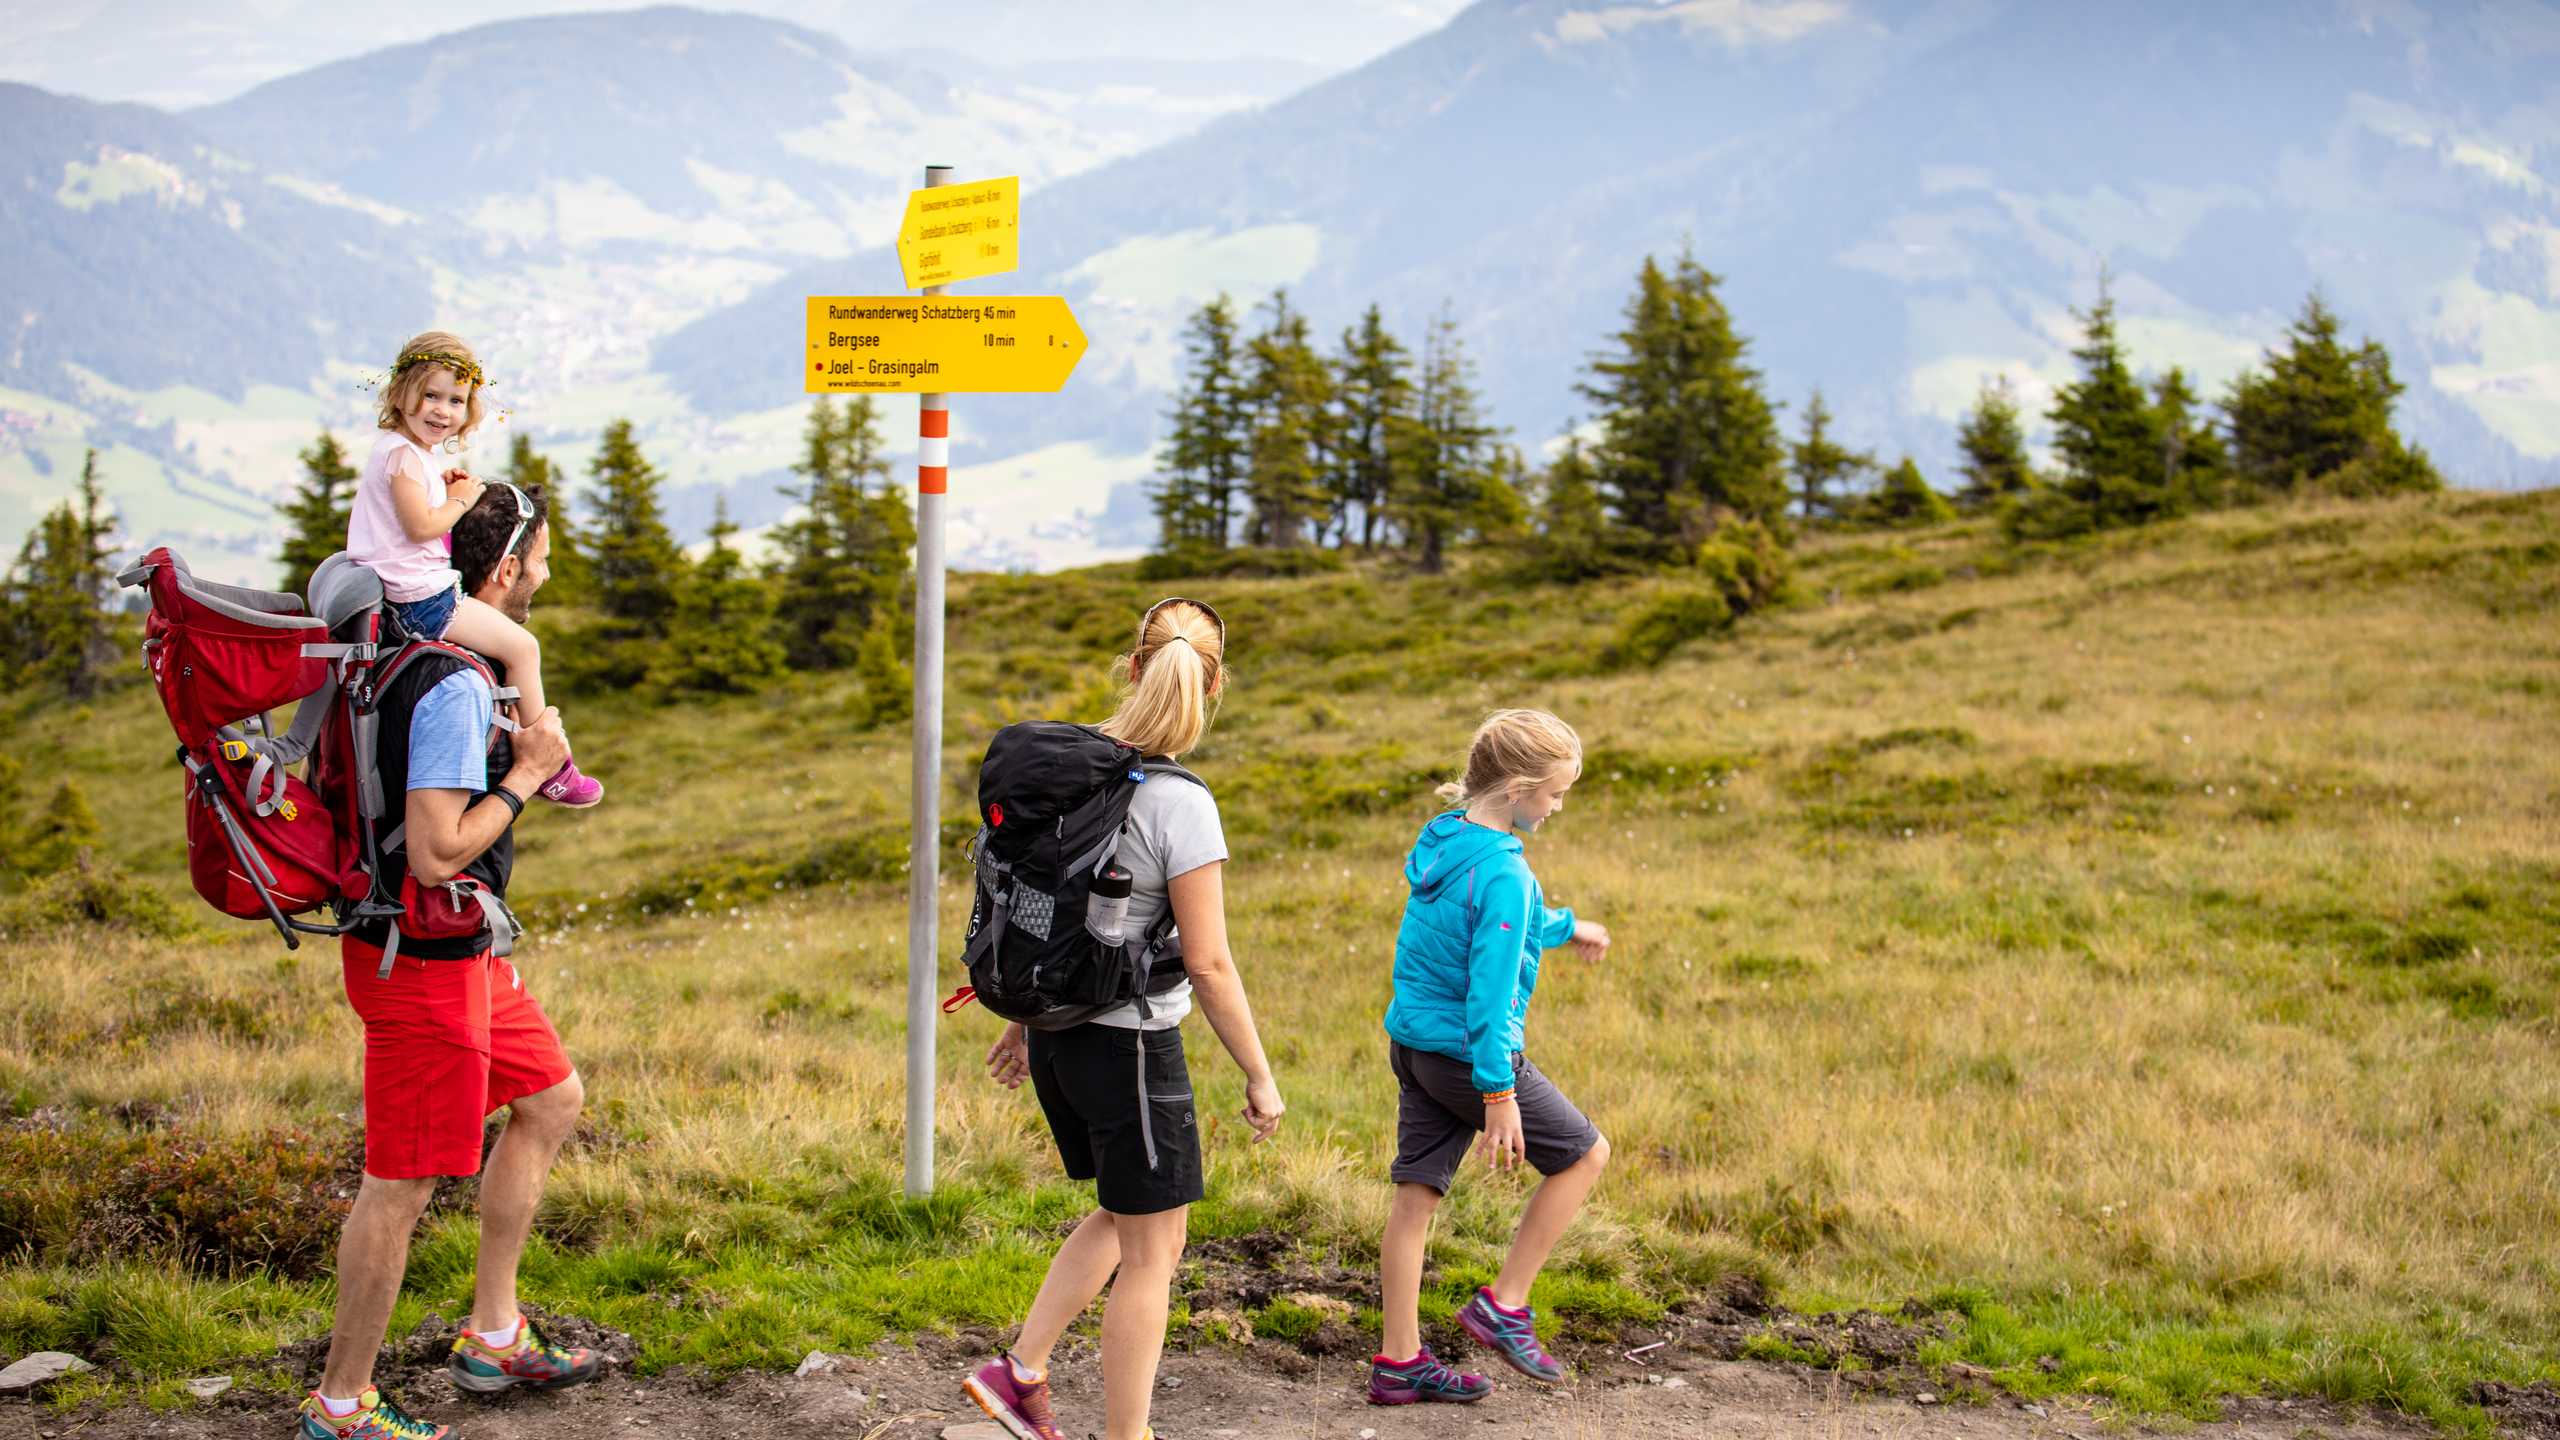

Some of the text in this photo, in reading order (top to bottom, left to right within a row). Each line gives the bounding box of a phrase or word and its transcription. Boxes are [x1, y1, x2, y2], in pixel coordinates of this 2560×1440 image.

[829, 304, 1016, 323] Rundwanderweg Schatzberg 45 min
[828, 332, 881, 352] Bergsee
[983, 333, 995, 347] 10
[995, 334, 1015, 347] min
[827, 359, 854, 375] Joel
[868, 359, 940, 379] Grasingalm
[548, 782, 567, 799] N
